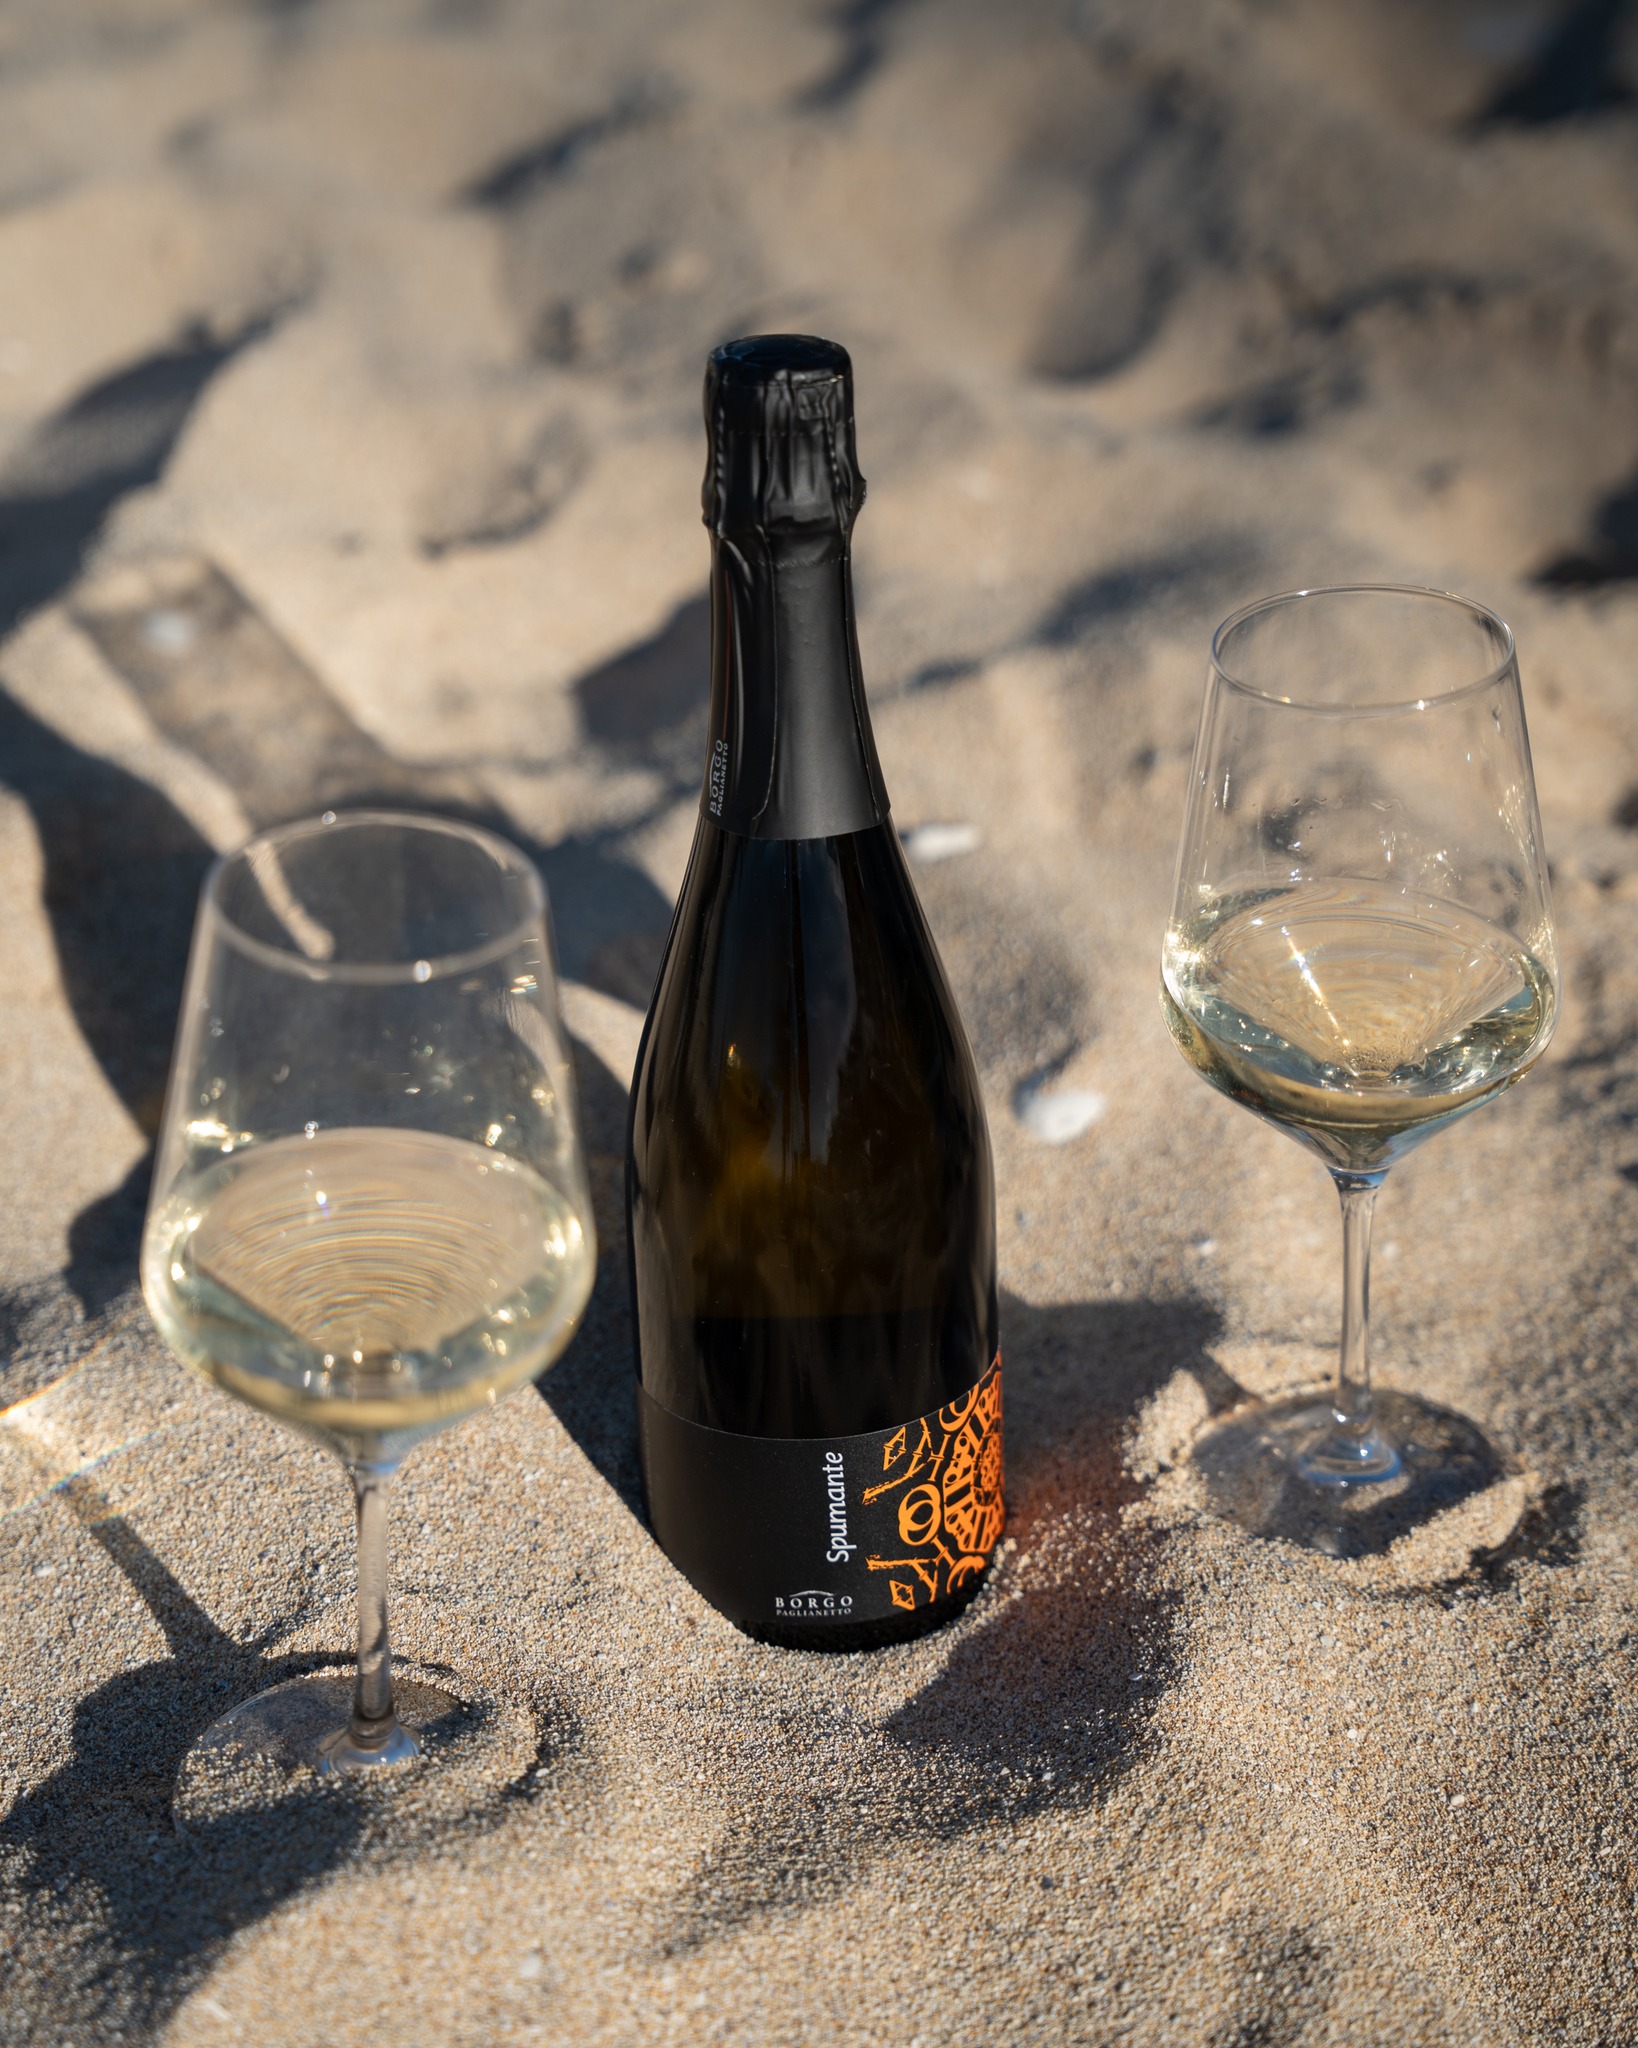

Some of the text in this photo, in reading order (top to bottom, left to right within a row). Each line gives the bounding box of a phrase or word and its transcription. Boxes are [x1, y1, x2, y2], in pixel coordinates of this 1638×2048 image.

[709, 740, 723, 814] BORGO
[822, 1451, 857, 1563] Spumante
[775, 1595, 853, 1609] BORGO
[776, 1607, 852, 1616] PAGLIANETTO
